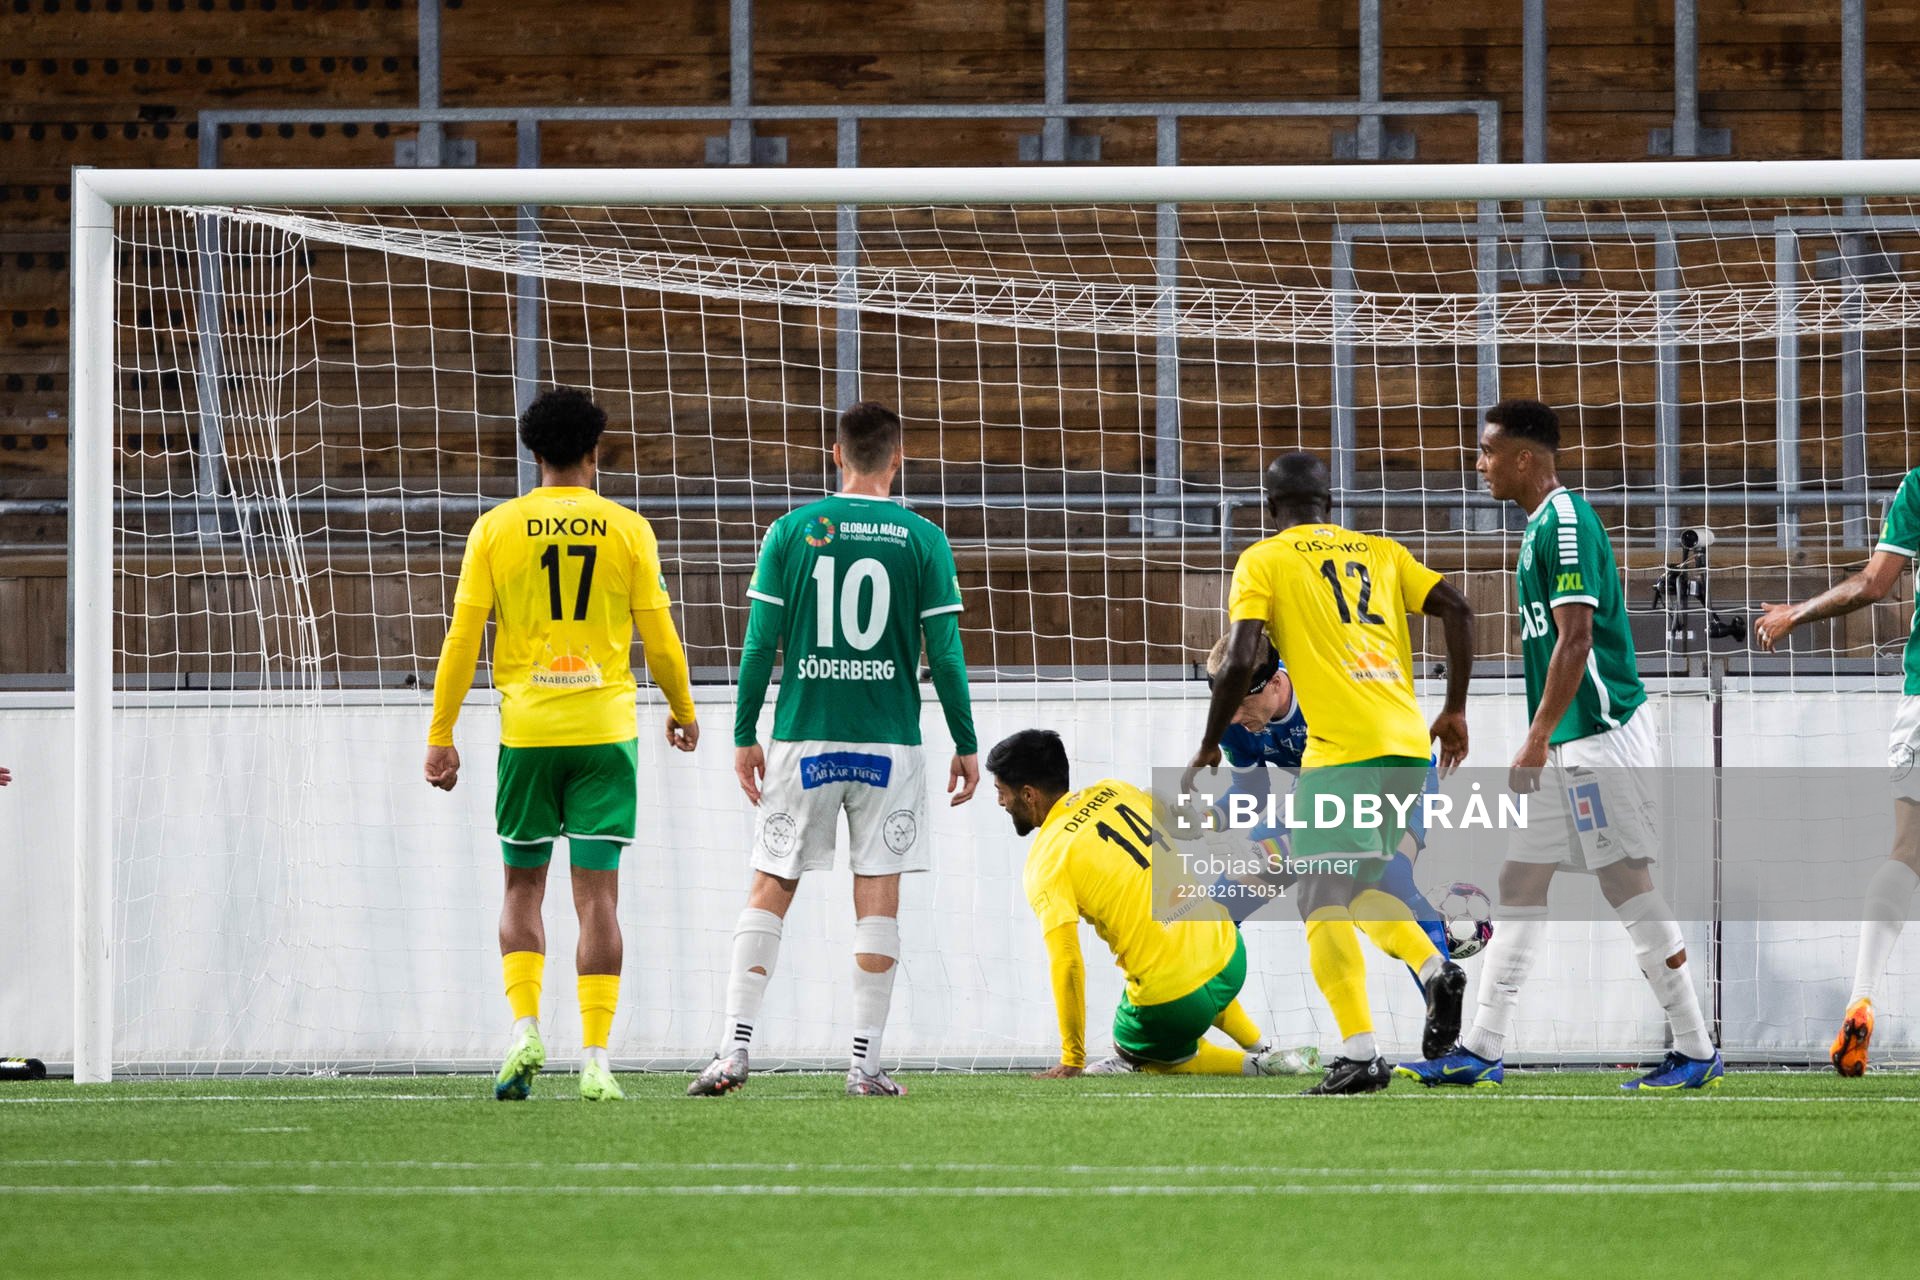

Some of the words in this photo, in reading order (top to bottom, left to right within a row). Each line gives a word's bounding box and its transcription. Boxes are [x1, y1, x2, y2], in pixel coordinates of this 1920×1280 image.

[527, 518, 607, 537] DIXON
[840, 521, 879, 535] GLOBALA
[879, 522, 909, 539] MÅLEN
[840, 533, 854, 541] för
[854, 533, 874, 542] hållbar
[874, 535, 907, 547] utveckling
[540, 544, 597, 621] 17
[1320, 559, 1385, 625] 12
[1556, 572, 1584, 592] XXL
[811, 555, 891, 651] 10
[532, 673, 599, 685] SNABBGROS
[797, 655, 896, 681] SÖDERBERG
[1064, 787, 1119, 833] DEPREM
[1095, 803, 1172, 870] 14
